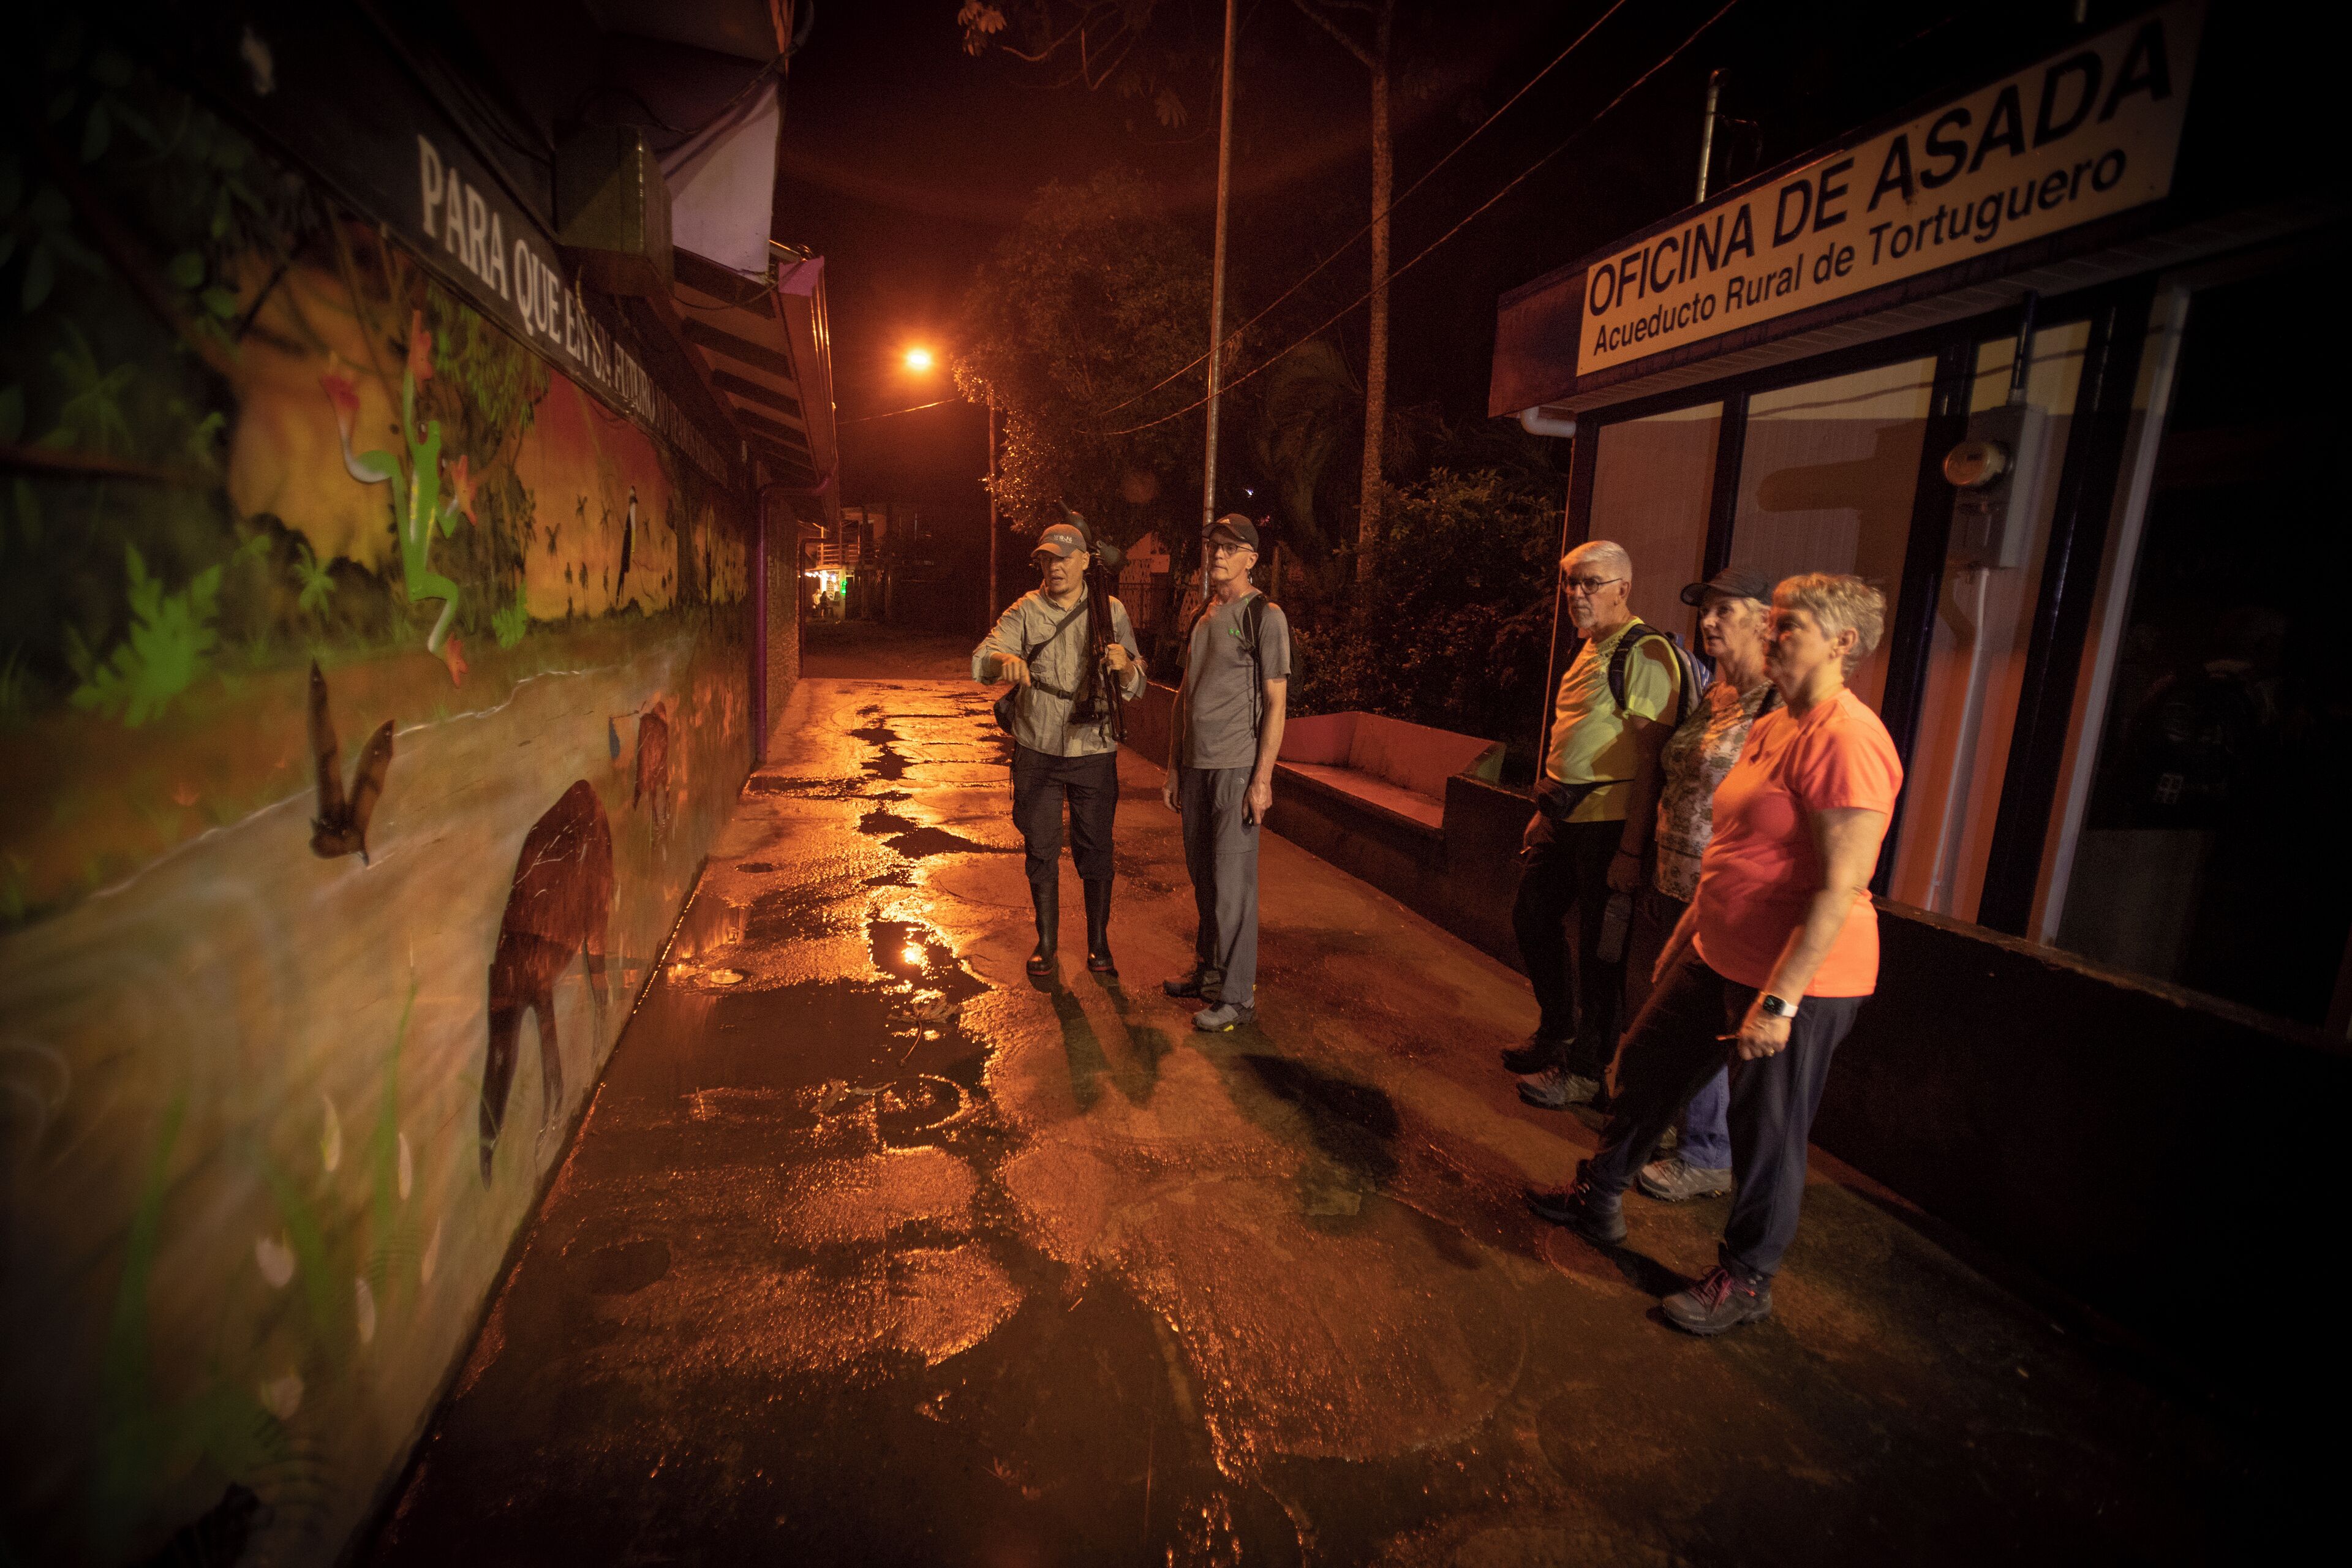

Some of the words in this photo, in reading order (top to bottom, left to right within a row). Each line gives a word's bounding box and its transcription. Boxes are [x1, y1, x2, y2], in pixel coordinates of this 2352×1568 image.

[418, 134, 510, 301] PARA
[514, 239, 561, 344] QUE
[1589, 203, 1755, 317] OFICINA
[1772, 157, 1854, 247] DE
[1868, 20, 2173, 209] ASADA
[1593, 288, 1716, 356] Acueducto
[1724, 254, 1803, 312] Rural
[1813, 239, 1854, 284] de
[1869, 148, 2126, 266] Tortuguero
